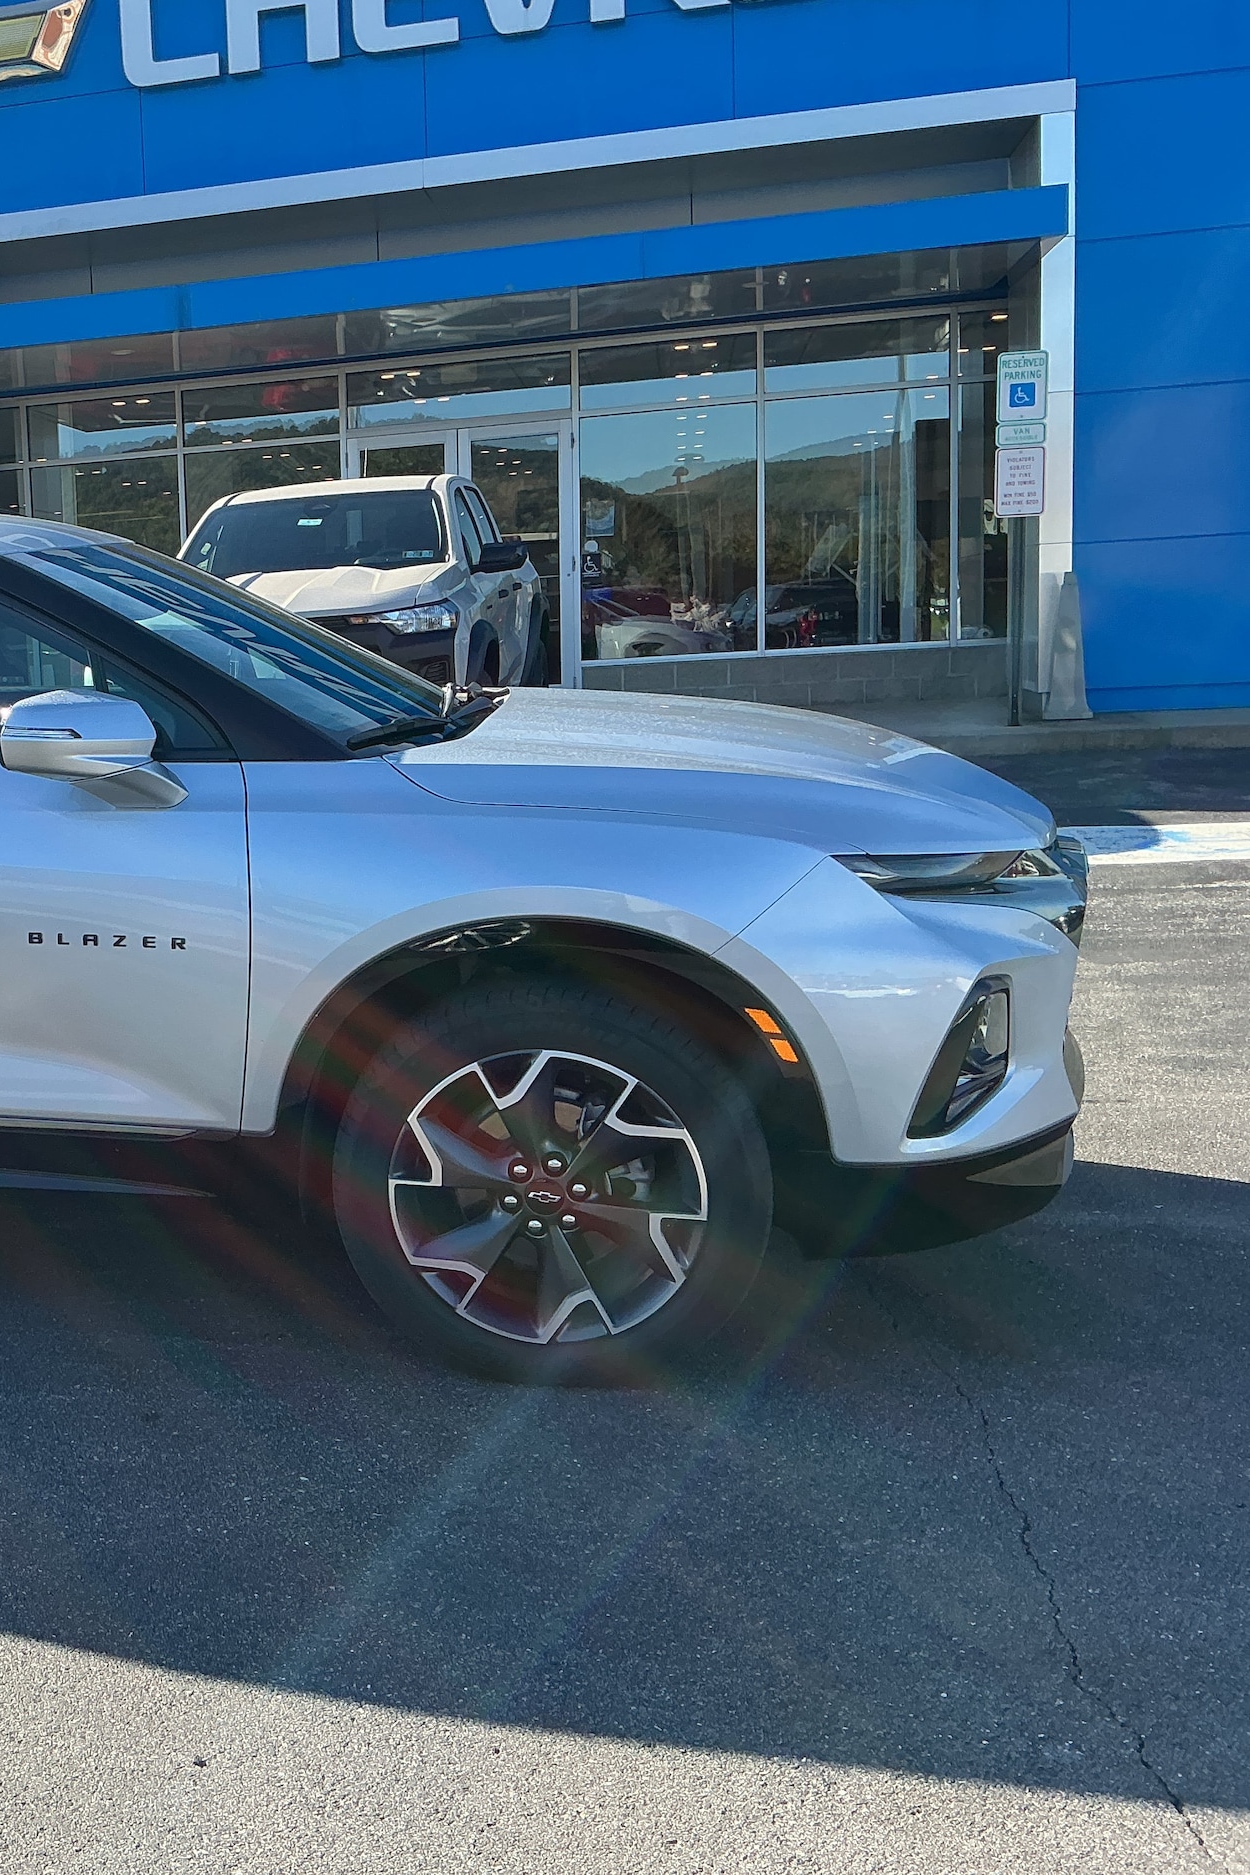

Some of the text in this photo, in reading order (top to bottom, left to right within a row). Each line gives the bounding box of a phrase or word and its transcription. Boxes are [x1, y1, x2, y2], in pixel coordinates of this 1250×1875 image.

[1002, 357, 1045, 369] RESERVED
[1004, 370, 1042, 380] PARKING
[1013, 427, 1031, 435] VAN
[28, 932, 186, 950] BLAZER
